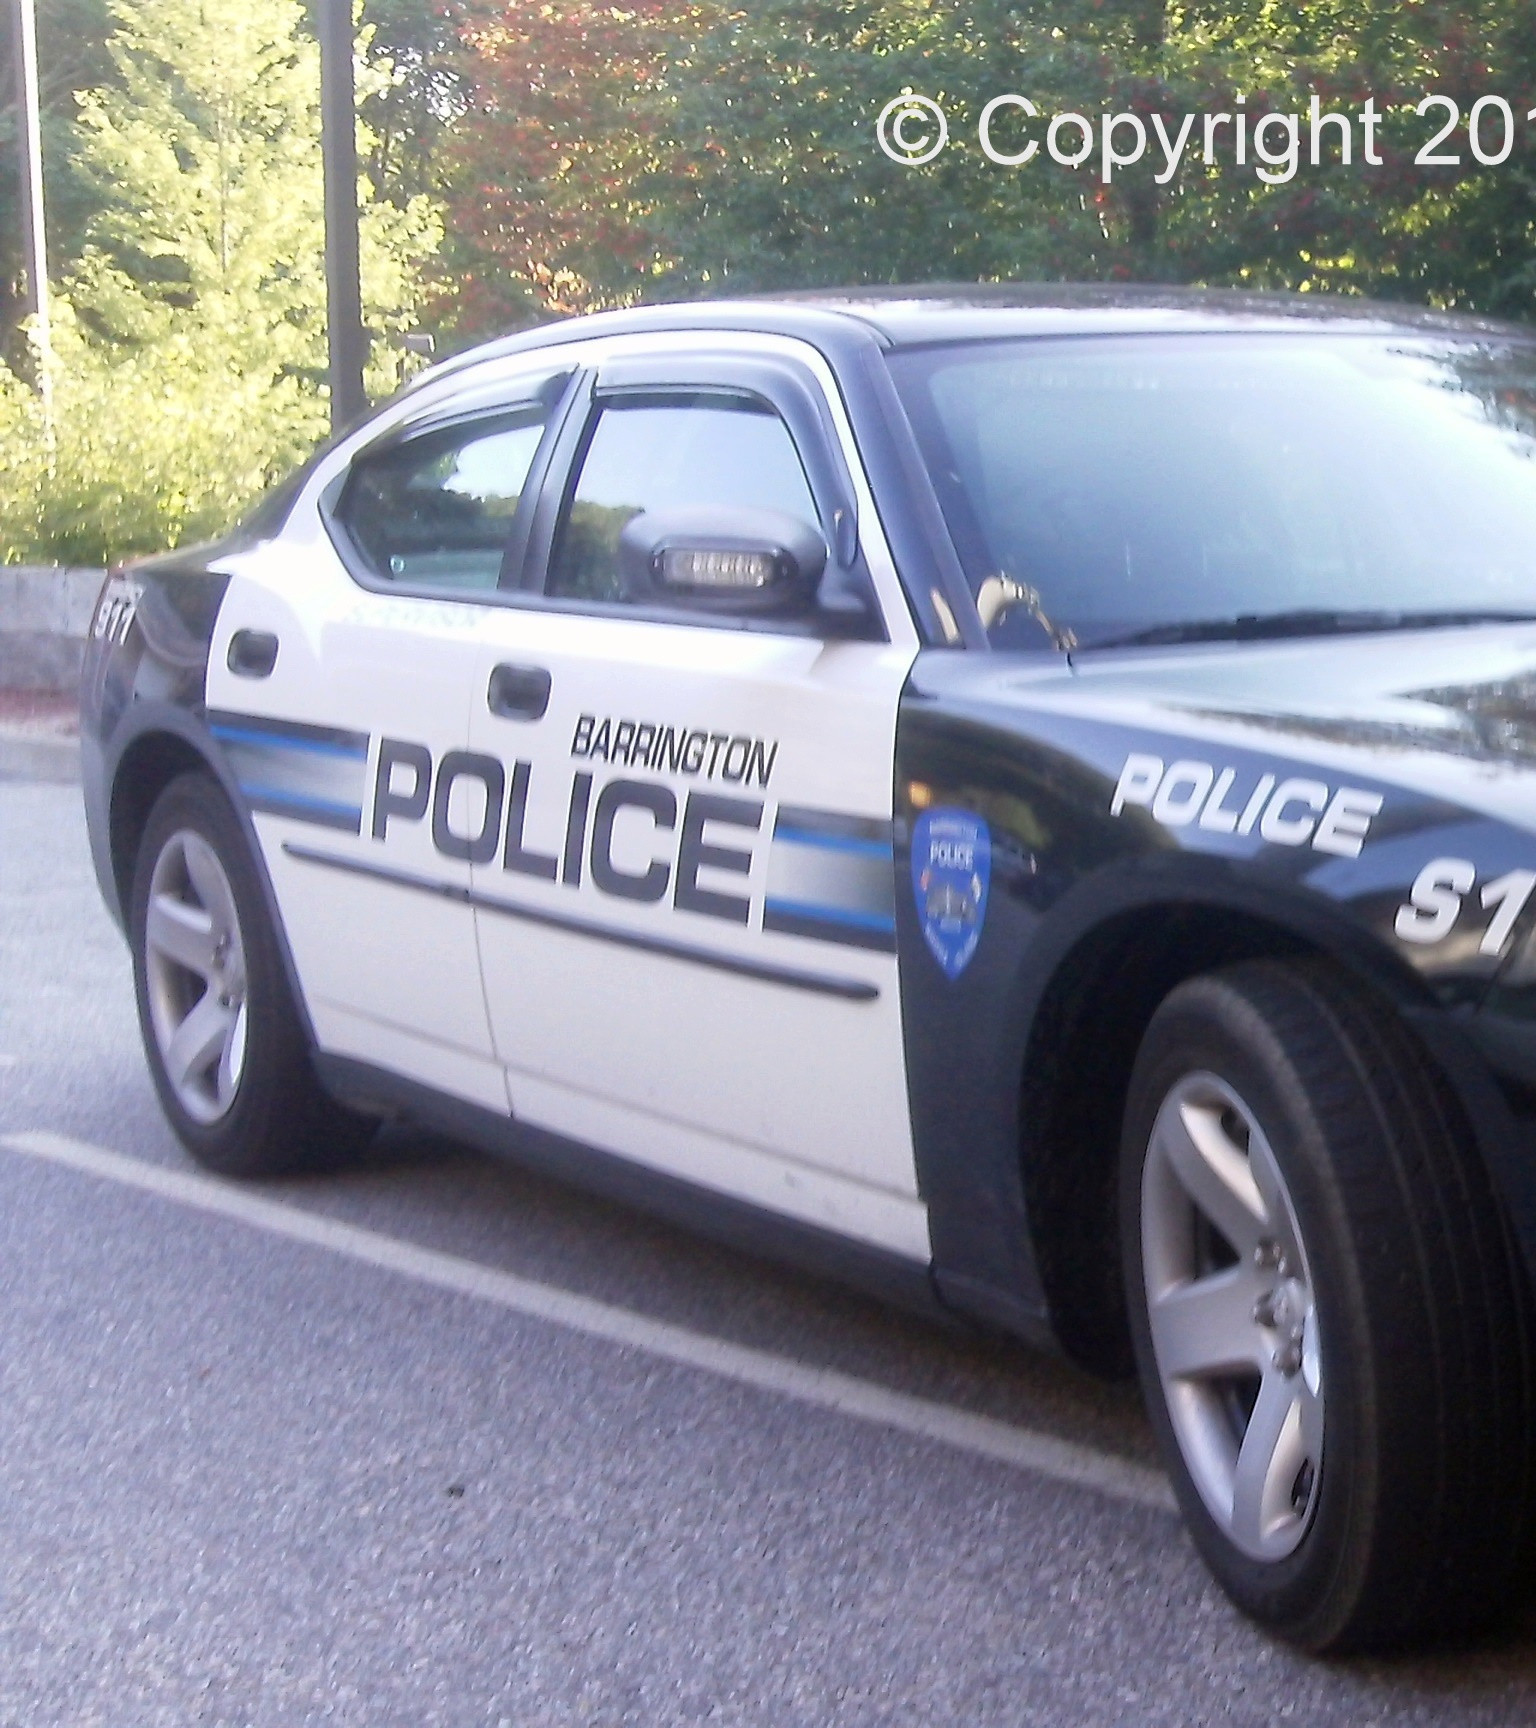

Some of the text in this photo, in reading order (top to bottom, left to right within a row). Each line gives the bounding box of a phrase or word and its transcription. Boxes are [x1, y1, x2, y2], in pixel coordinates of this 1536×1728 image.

[571, 714, 778, 788] BARRINGTON
[371, 738, 766, 924] POLICE
[1110, 753, 1384, 858] POLICE
[929, 840, 974, 872] POLICE
